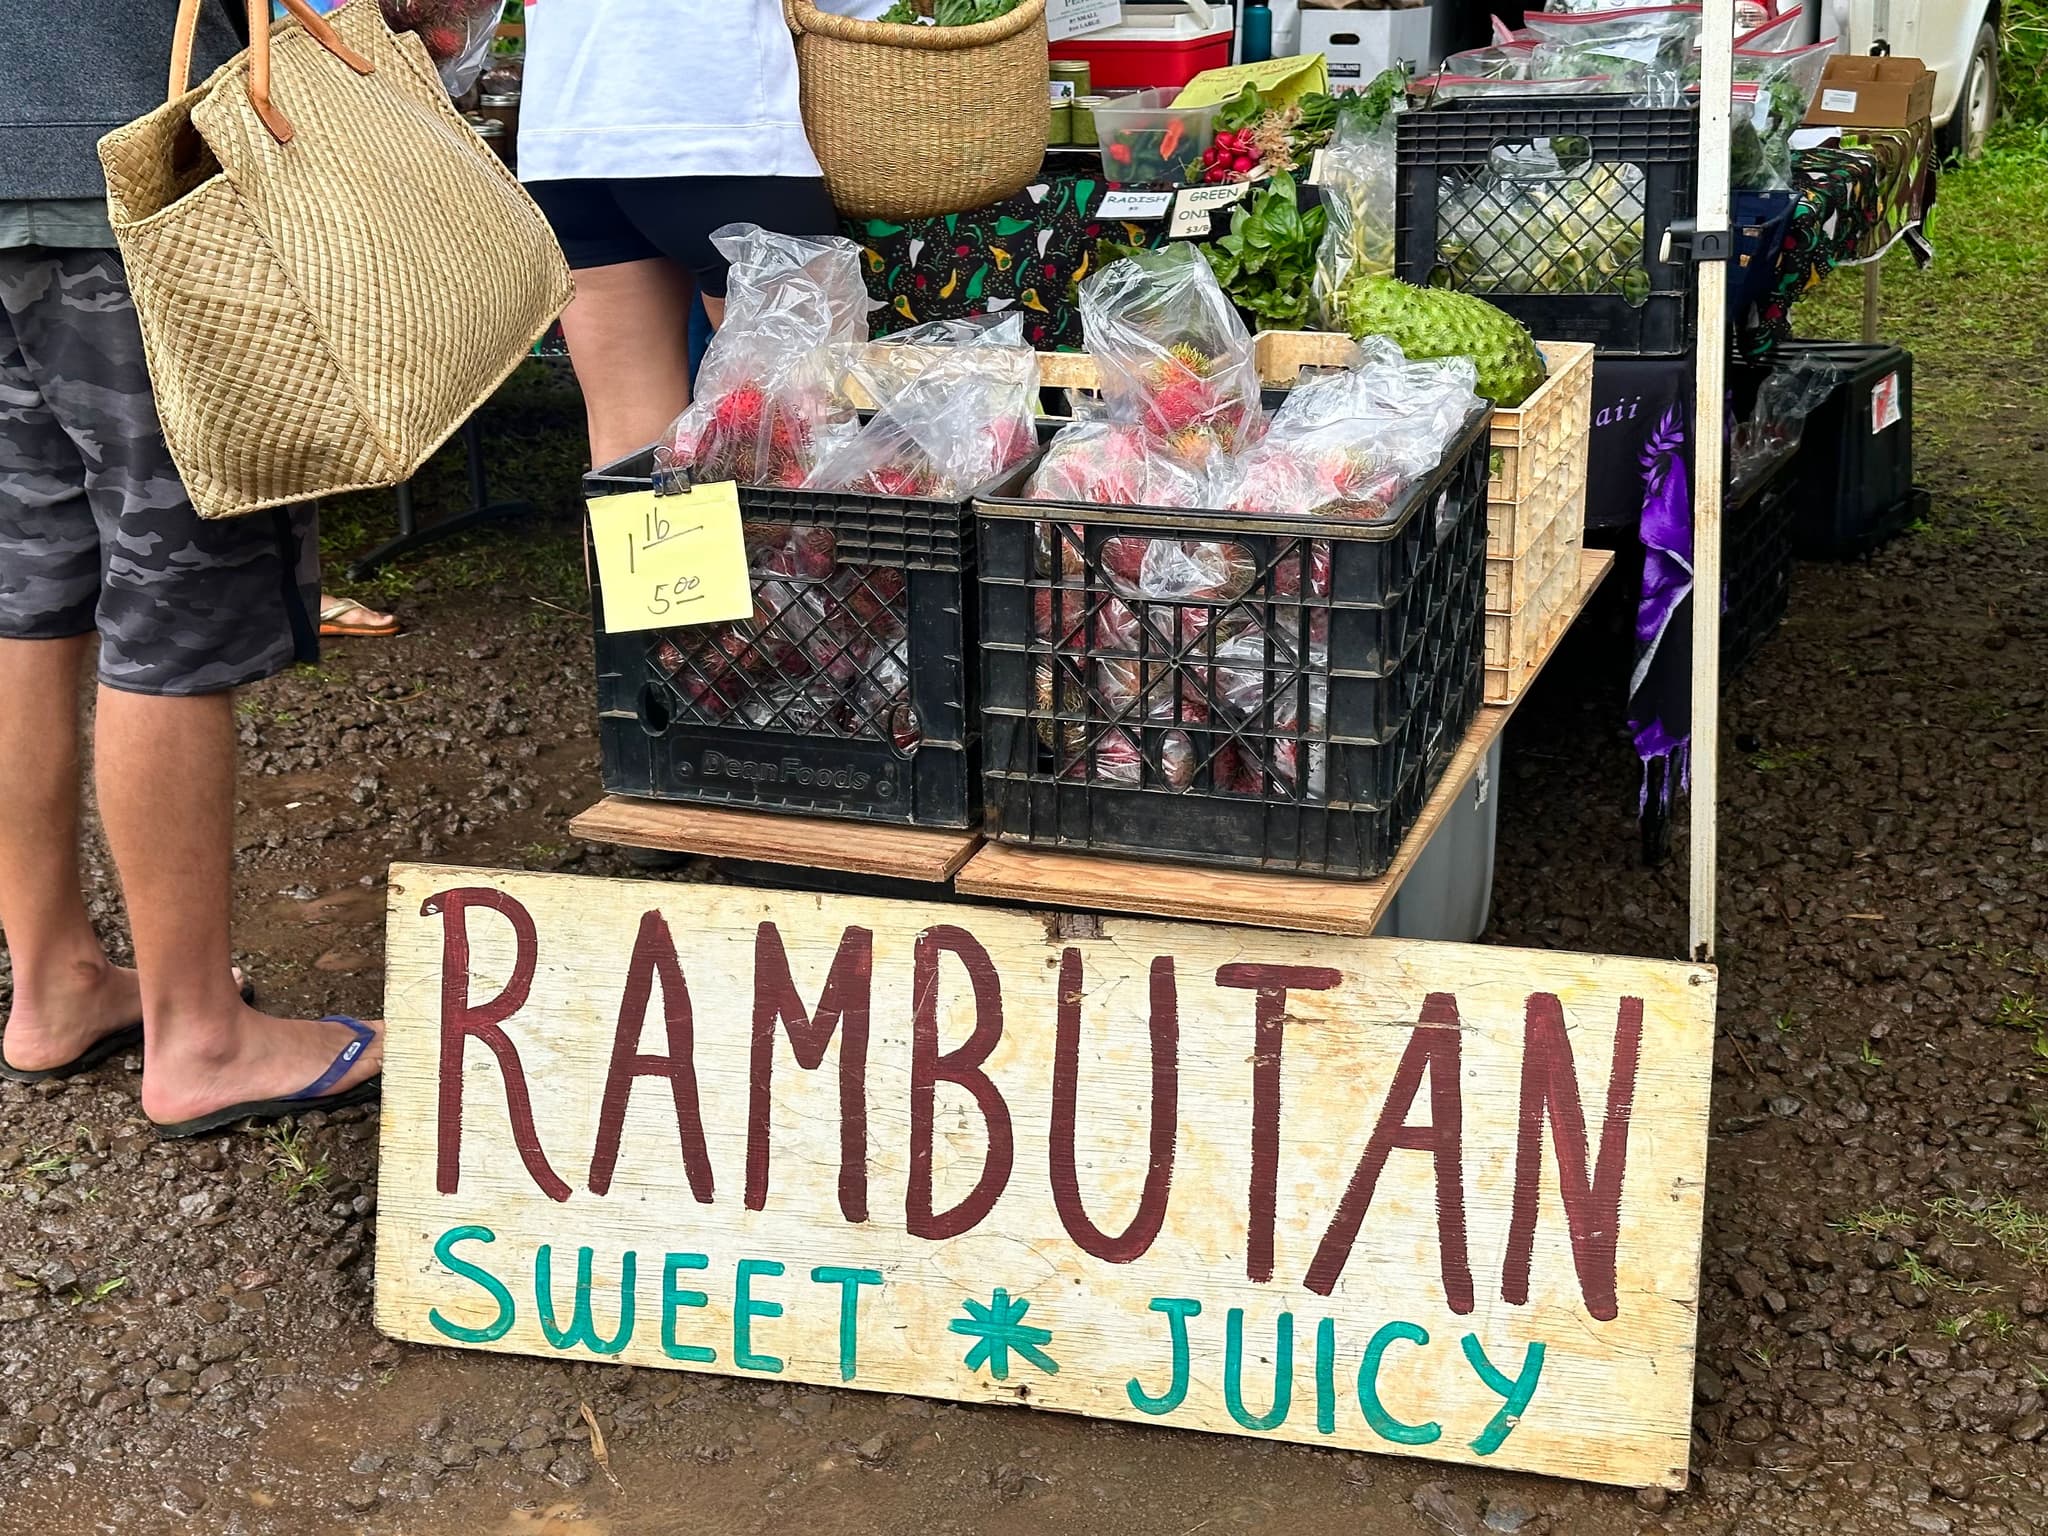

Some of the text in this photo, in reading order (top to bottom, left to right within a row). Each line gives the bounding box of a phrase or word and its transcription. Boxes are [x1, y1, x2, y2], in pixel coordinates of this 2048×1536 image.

[1106, 195, 1168, 204] RADISH
[1189, 187, 1239, 202] GREEN
[419, 886, 1644, 1322] RAMBUTAN
[428, 1224, 1547, 1456] SWEET JUICY
